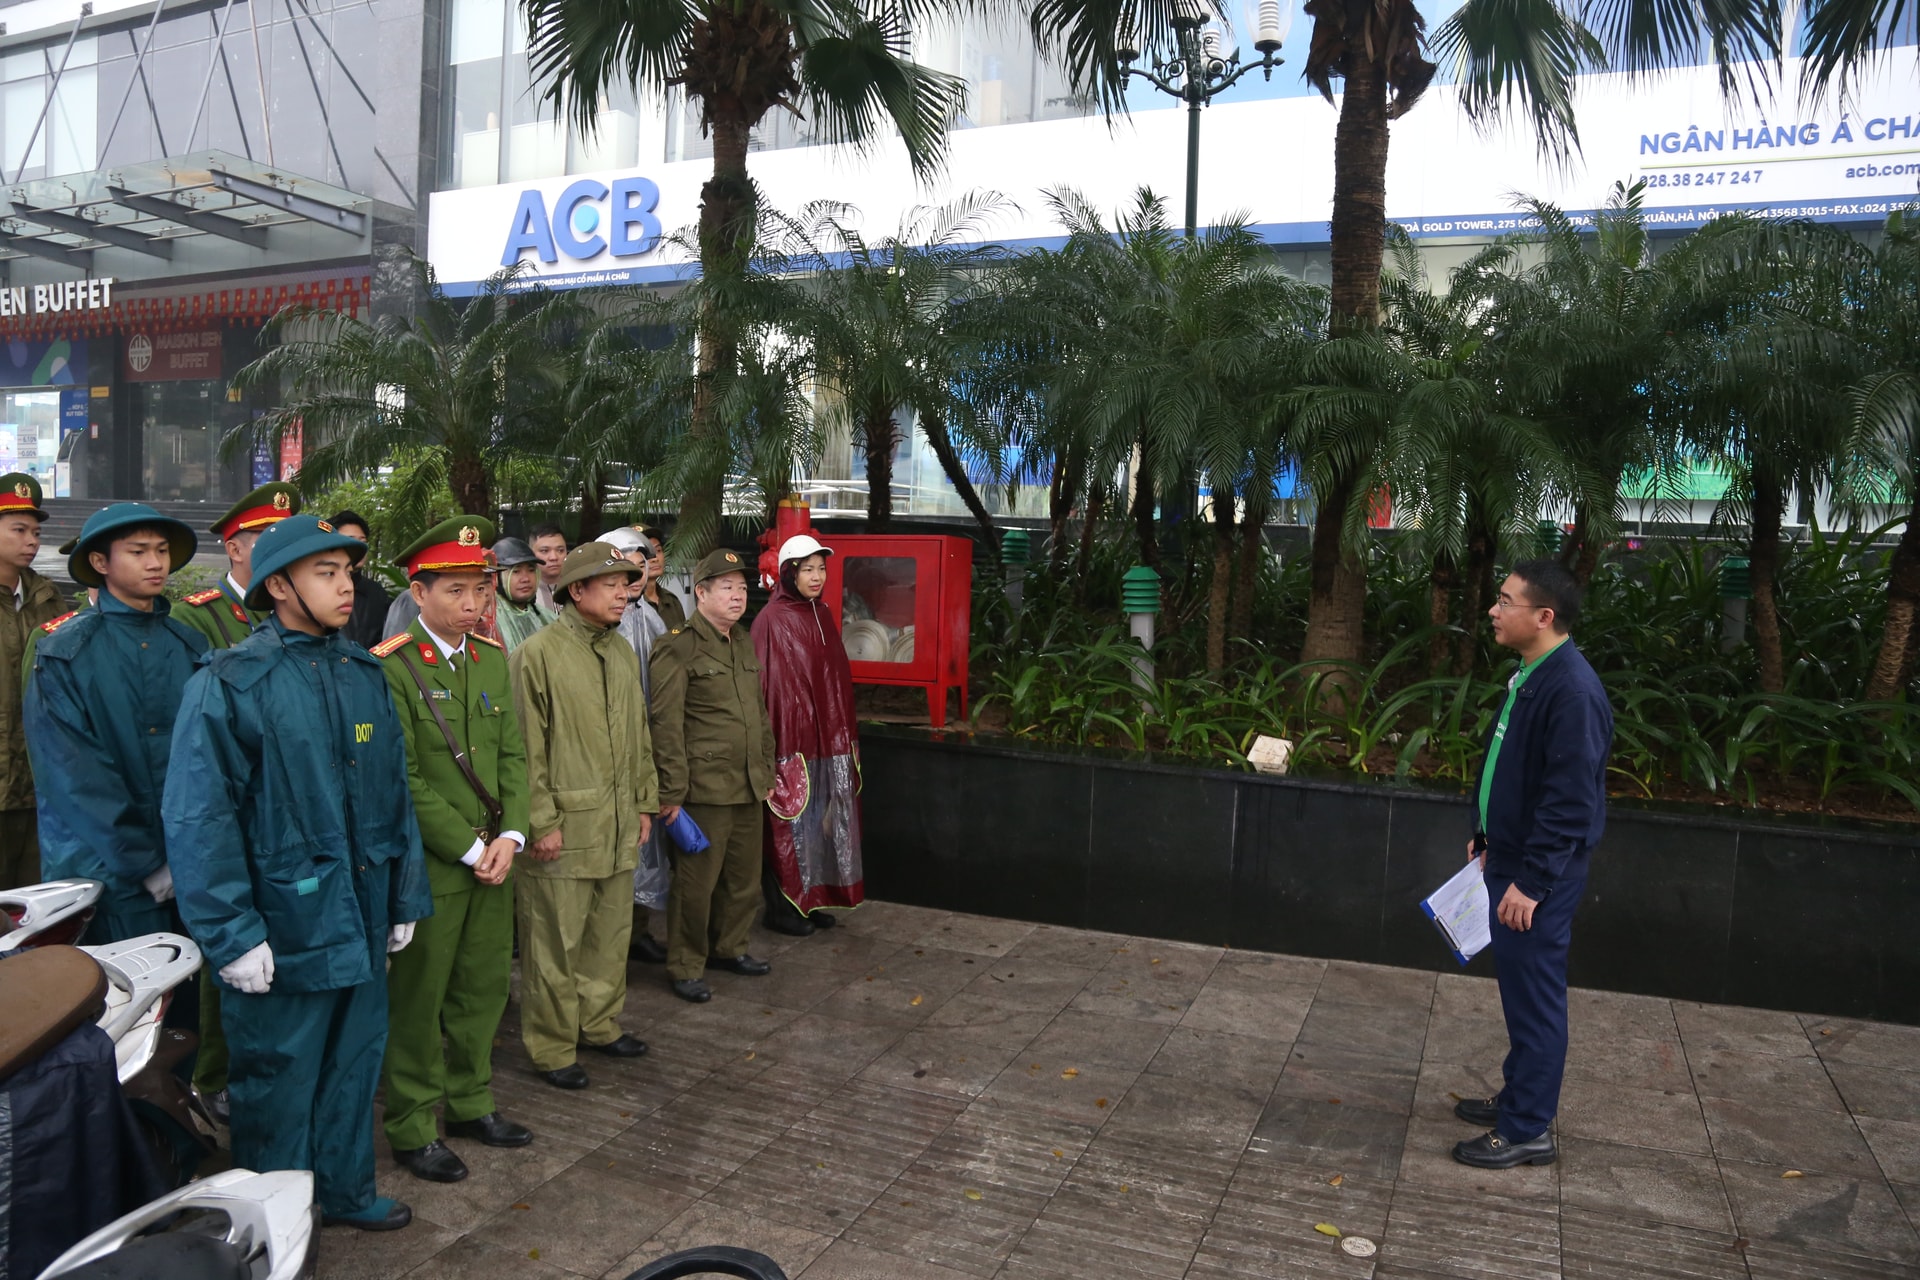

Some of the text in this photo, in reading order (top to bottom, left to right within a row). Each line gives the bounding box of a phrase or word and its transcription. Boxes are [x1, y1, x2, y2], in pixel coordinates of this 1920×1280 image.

[1640, 124, 1724, 155] NGÂN
[1732, 119, 1820, 150] HÀNG
[1831, 113, 1854, 144] Á
[1845, 163, 1920, 178] acb.com
[500, 177, 662, 267] ACB
[1422, 222, 1452, 232] GOLD
[1770, 207, 1798, 218] 3568
[34, 278, 113, 314] BUFFET
[170, 352, 209, 369] BUFFET
